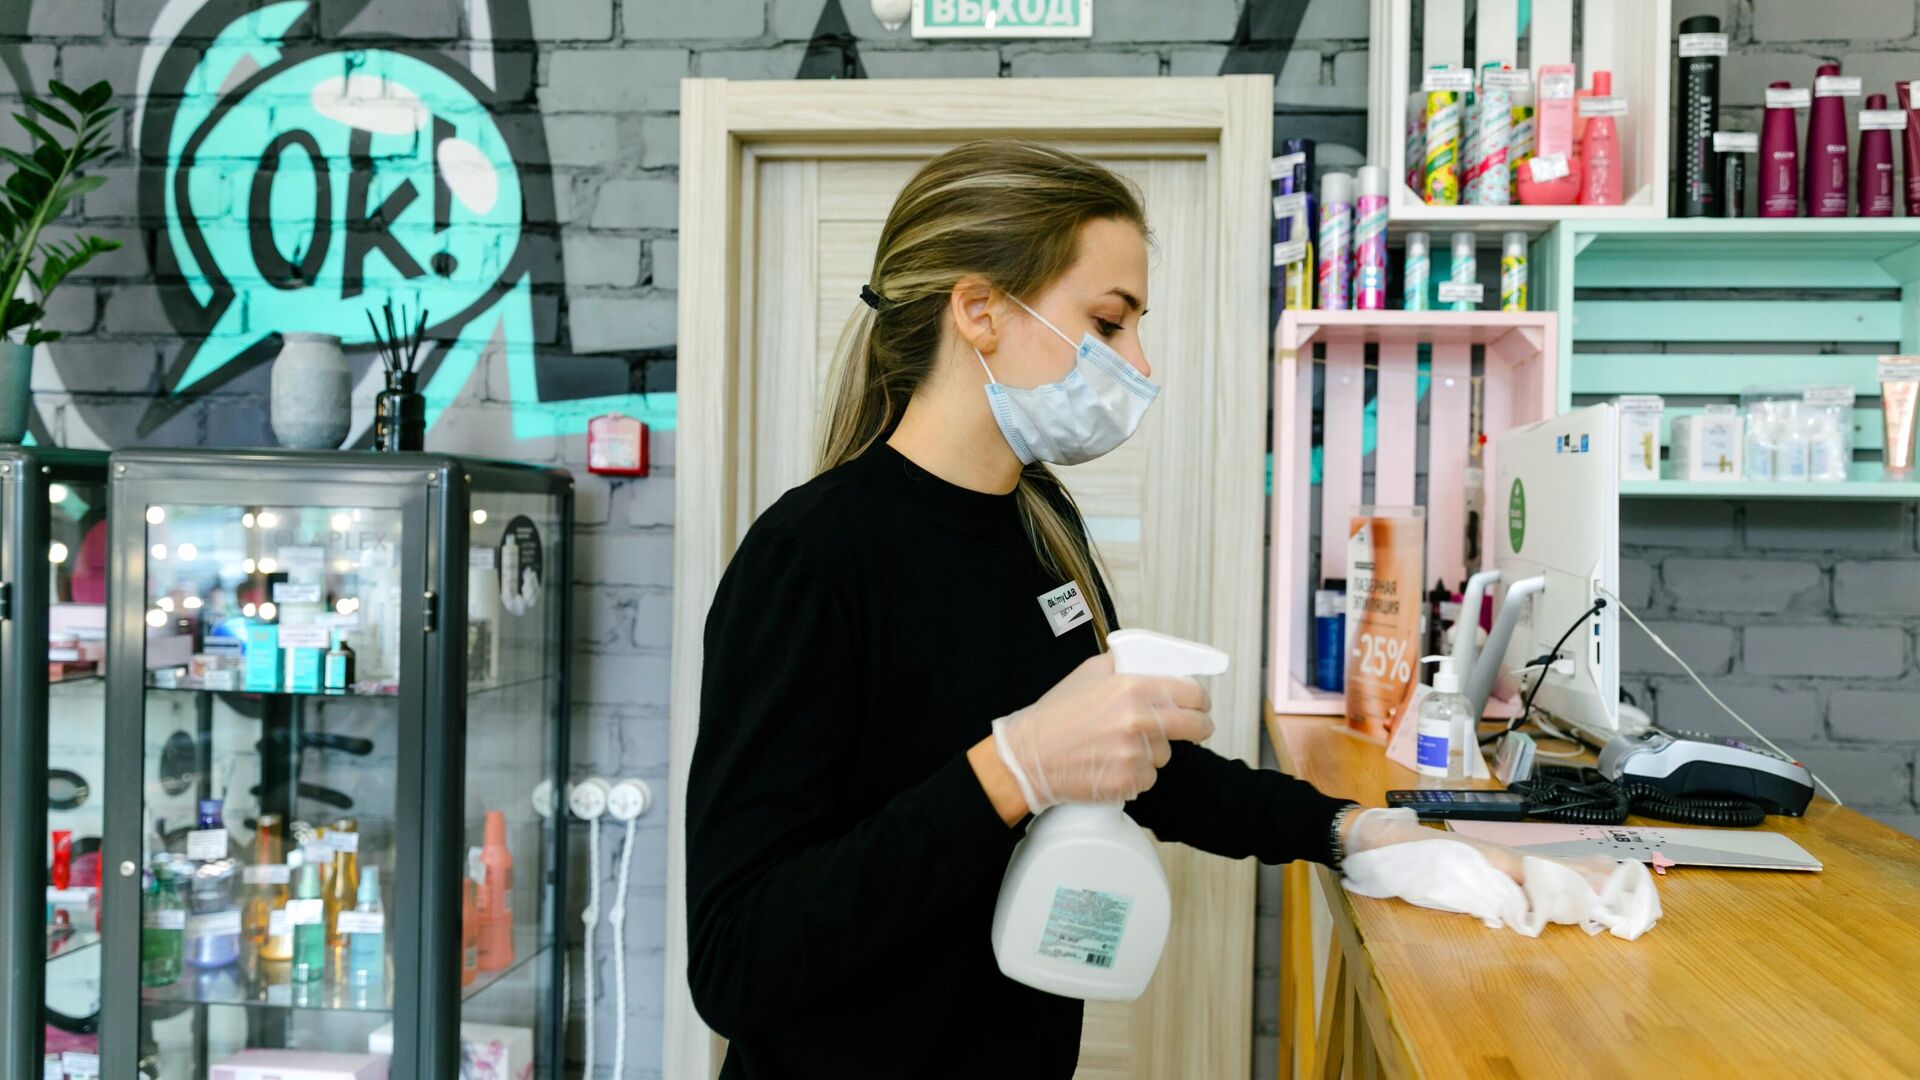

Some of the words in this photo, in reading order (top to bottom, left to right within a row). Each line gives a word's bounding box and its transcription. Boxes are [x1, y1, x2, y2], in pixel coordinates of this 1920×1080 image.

[932, 0, 1075, 25] ВЫХОД
[1699, 96, 1712, 138] STYLE
[1352, 633, 1411, 683] -25%
